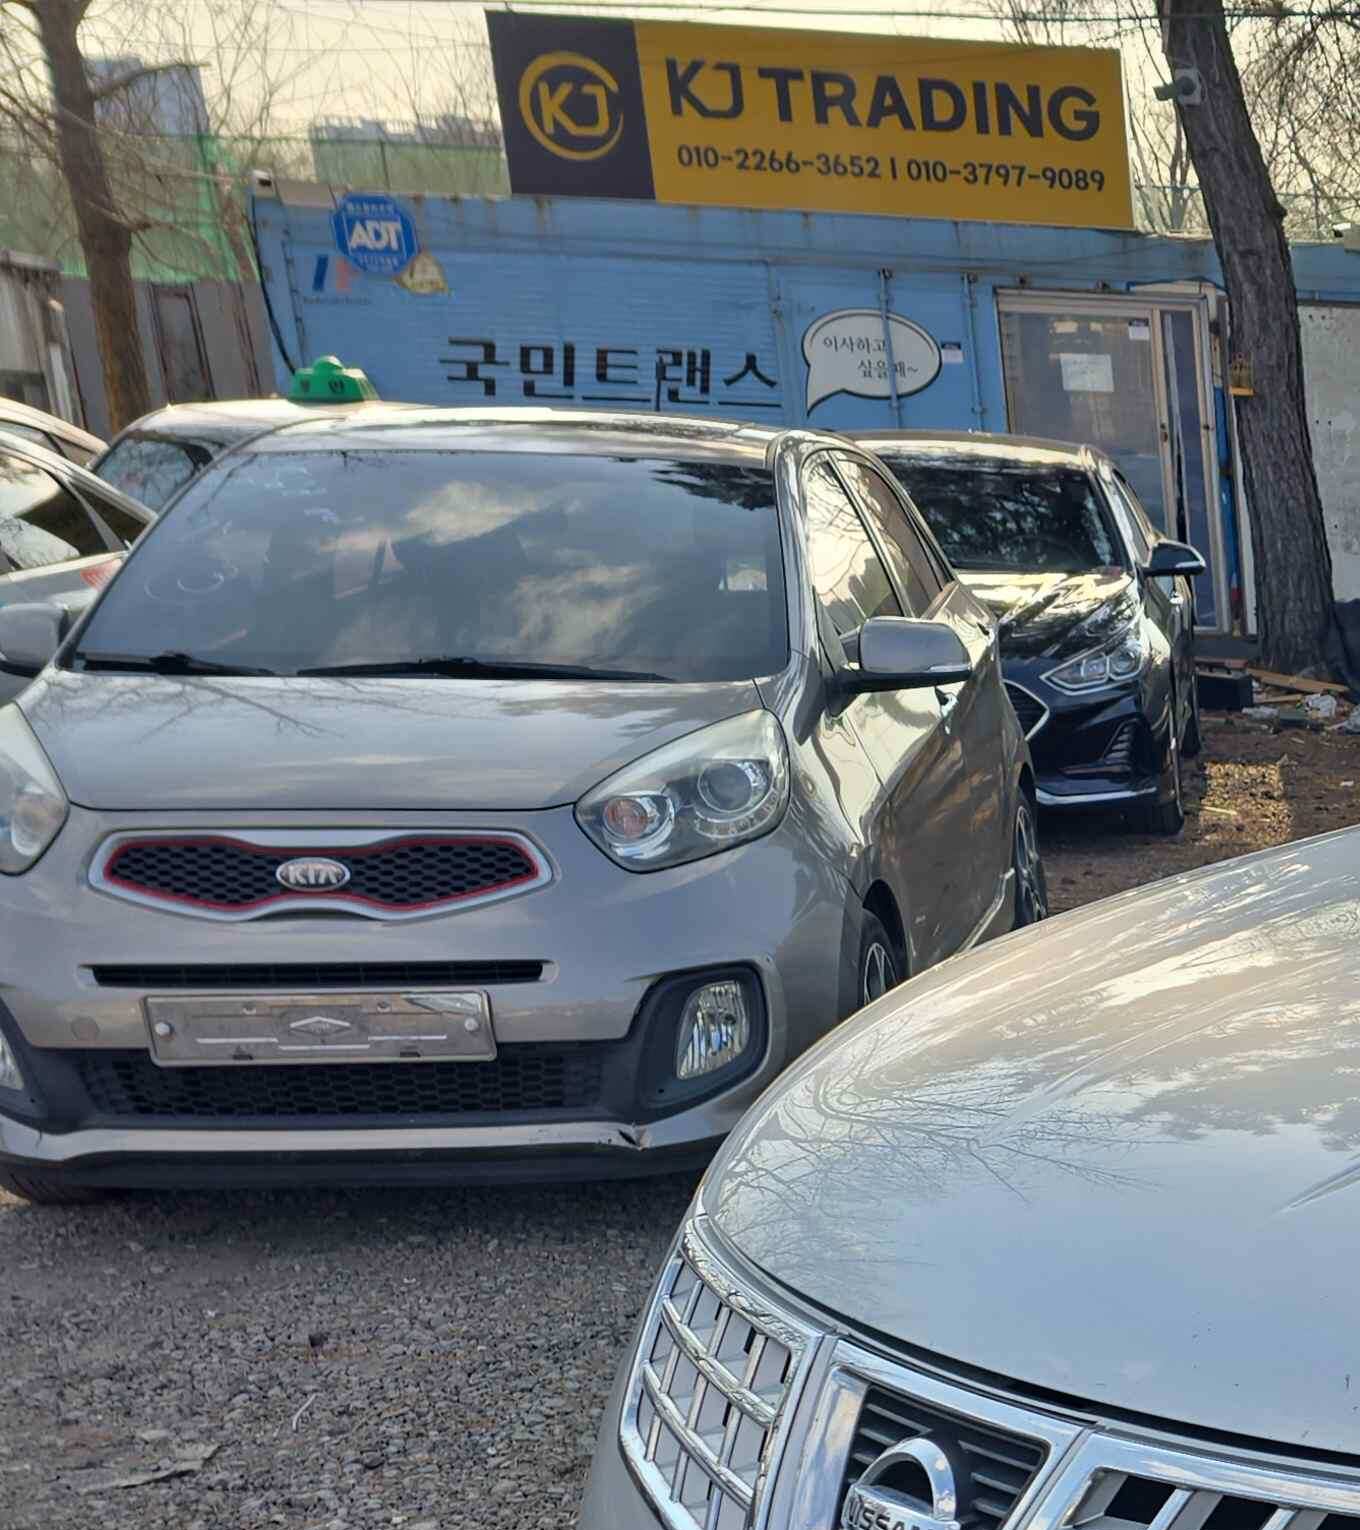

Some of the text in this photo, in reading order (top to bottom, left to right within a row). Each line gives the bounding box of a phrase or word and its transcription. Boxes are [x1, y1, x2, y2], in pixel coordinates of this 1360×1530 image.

[537, 79, 611, 136] KJ
[665, 57, 1101, 142] KJ TRADING
[677, 144, 1106, 192] 010-2266-3652 010-3797-9089
[350, 219, 403, 251] ADT
[439, 336, 782, 408] 국민트랜스
[288, 863, 338, 884] KIA
